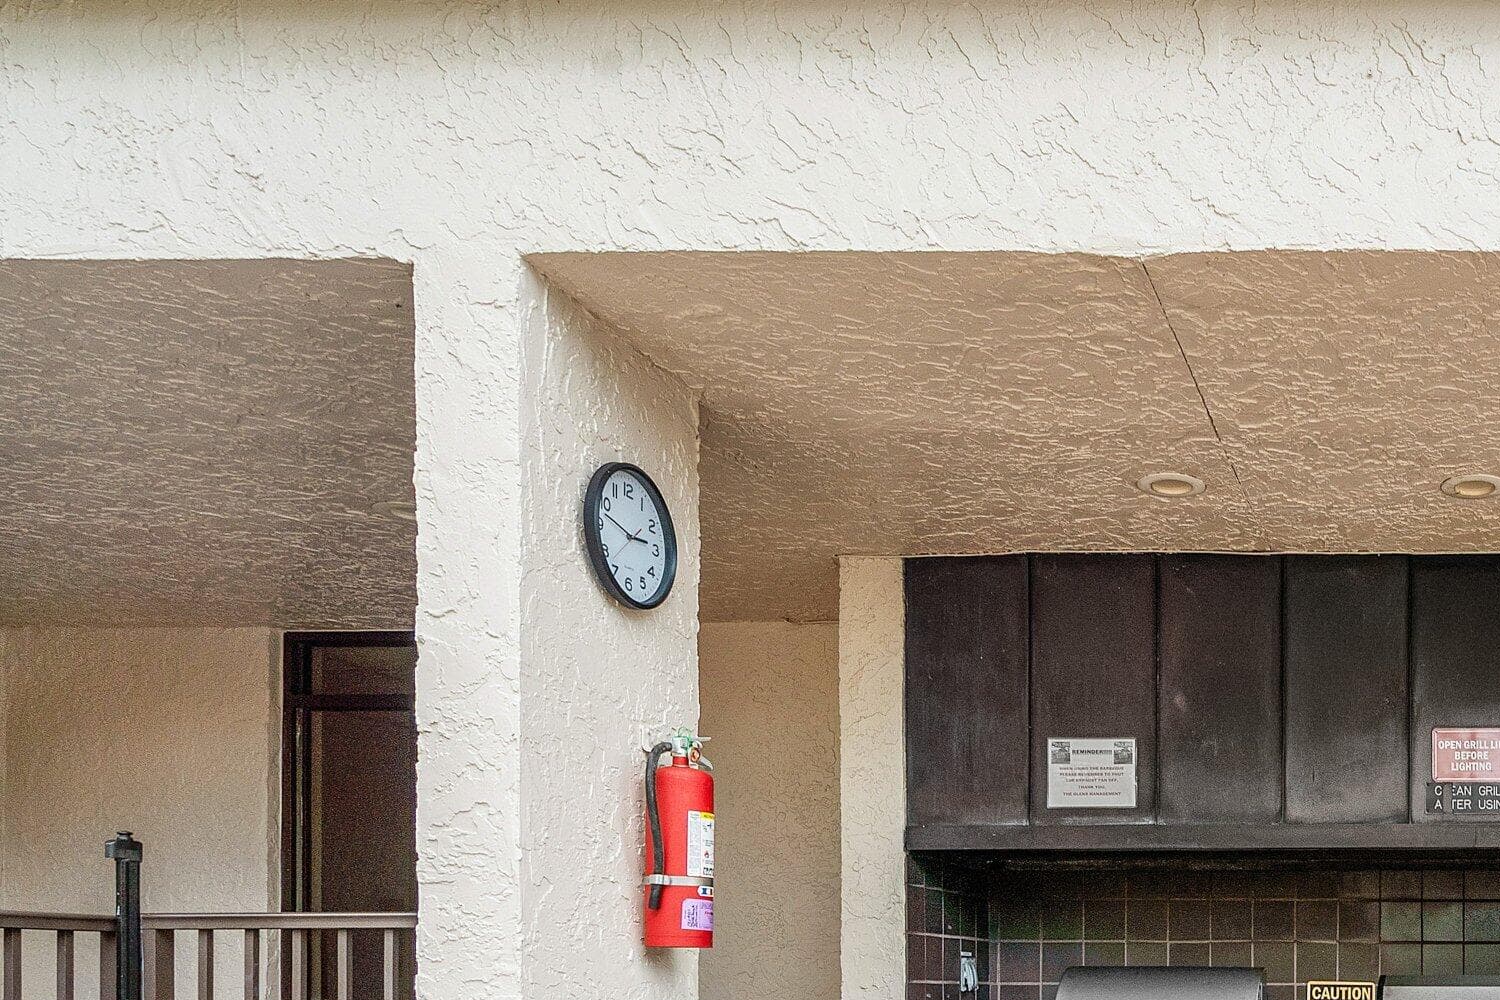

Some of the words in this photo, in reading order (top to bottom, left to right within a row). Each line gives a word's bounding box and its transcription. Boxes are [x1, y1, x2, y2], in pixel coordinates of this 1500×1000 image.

[612, 482, 618, 499] 11
[623, 481, 634, 500] 12
[640, 497, 644, 512] 1
[648, 519, 656, 534] 2
[652, 544, 660, 557] 3
[611, 564, 619, 575] 7
[647, 566, 656, 577] 4
[625, 577, 633, 592] 6
[640, 576, 647, 589] 5
[1438, 740, 1462, 749] OPEN
[1464, 740, 1489, 749] GRILL
[1455, 751, 1489, 760] BEFORE
[1451, 762, 1492, 771] LIGHTING
[1434, 799, 1472, 810] ATER
[1312, 986, 1371, 1000] CAUTION
